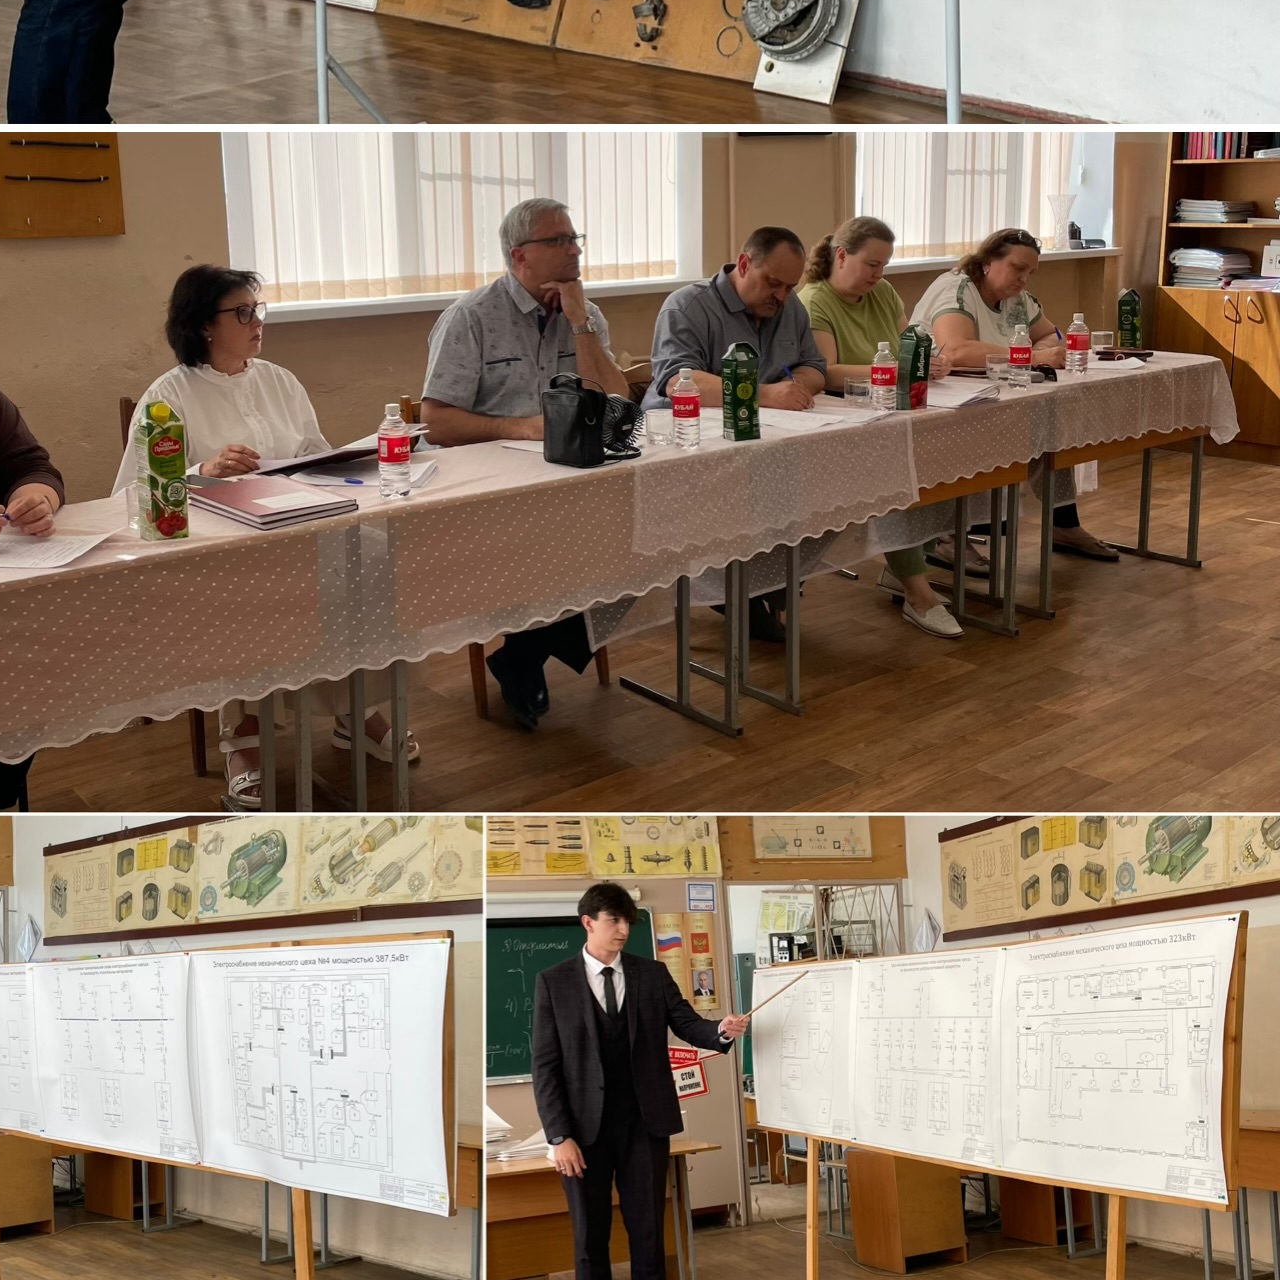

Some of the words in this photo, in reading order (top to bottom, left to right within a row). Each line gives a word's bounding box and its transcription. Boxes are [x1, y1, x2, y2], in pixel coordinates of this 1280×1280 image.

[917, 347, 925, 377] Добрый
[674, 403, 694, 411] КУБАЙ
[394, 446, 410, 454] КУБА
[1029, 949, 1075, 961] Электроснабжение
[1075, 944, 1114, 955] механического
[1115, 942, 1128, 950] цеха
[1128, 937, 1167, 948] мощностью
[1168, 932, 1196, 943] 323кВт
[213, 961, 257, 969] Электроснабжение
[300, 958, 317, 966] цеха
[331, 957, 374, 965] мощностью
[375, 954, 409, 963] 387,5кВт
[681, 1069, 696, 1081] СТОЙ
[679, 1081, 702, 1092] НАПРЯЖЕНИЕ
